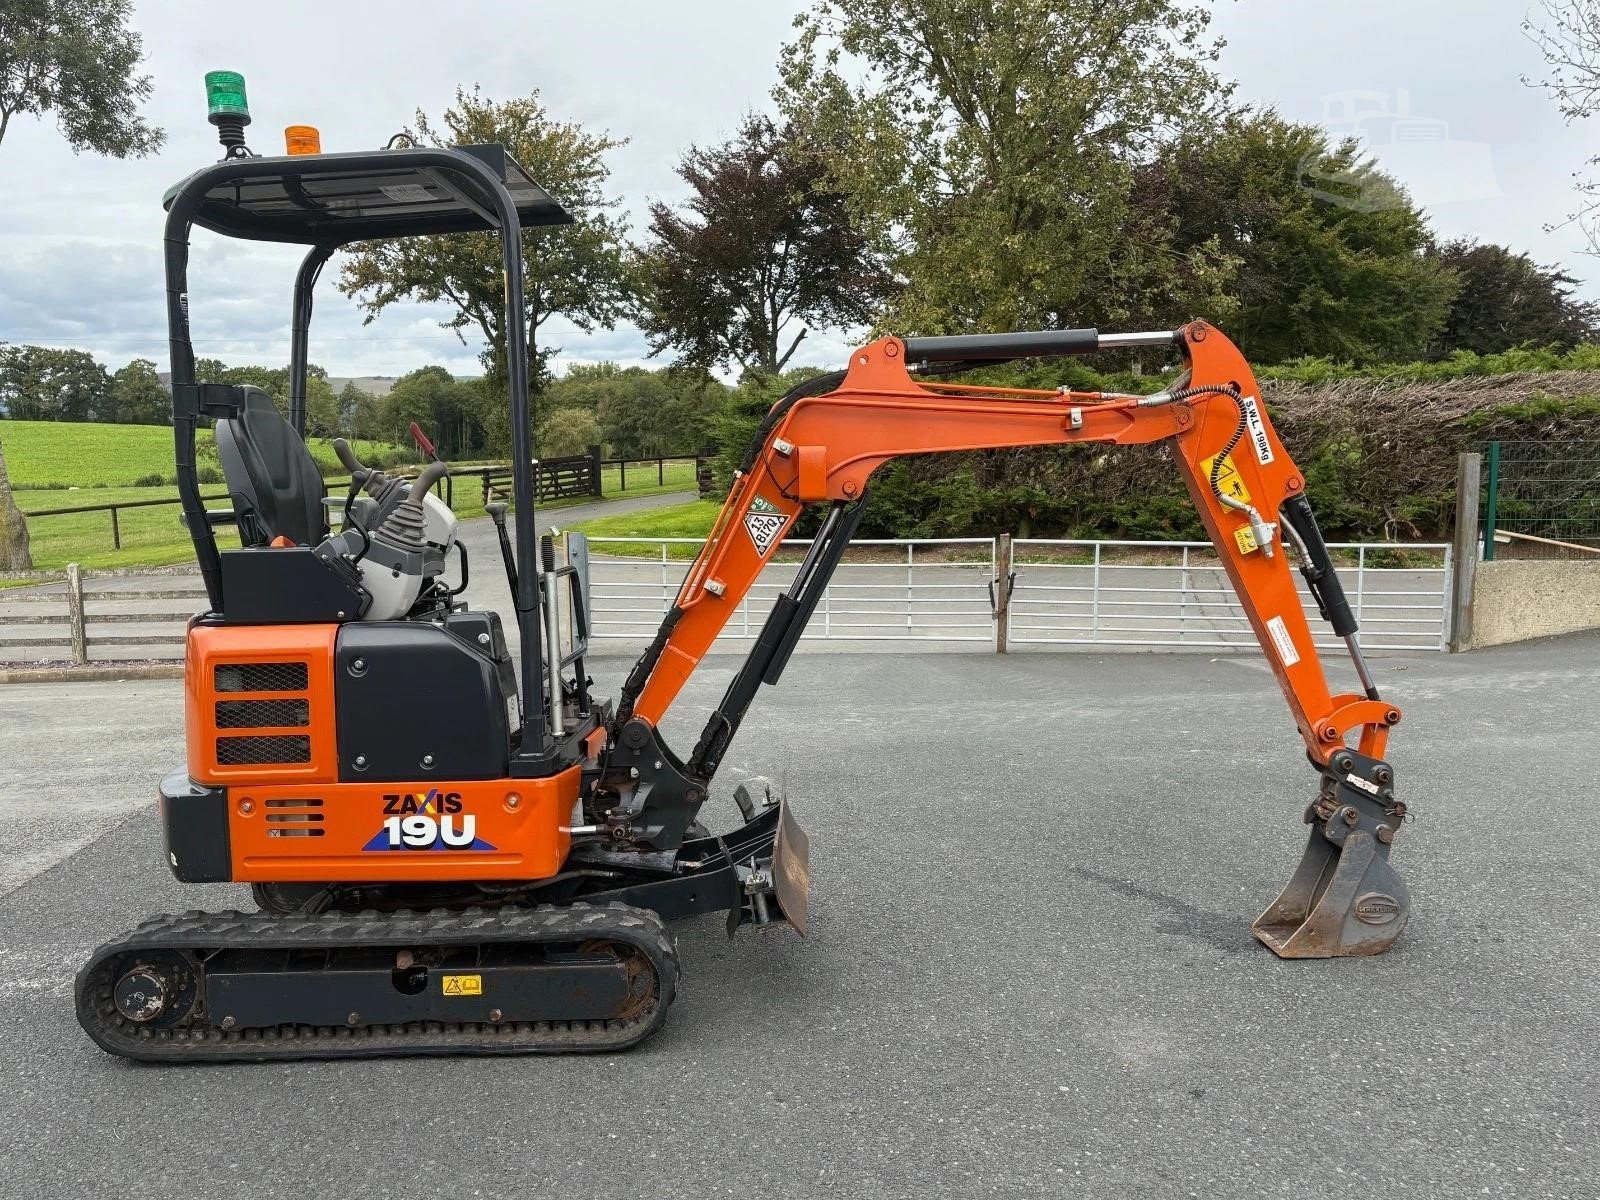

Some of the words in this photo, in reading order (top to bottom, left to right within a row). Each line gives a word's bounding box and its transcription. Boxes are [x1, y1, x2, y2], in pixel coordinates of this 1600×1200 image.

[1246, 400, 1259, 429] S.W.L.
[1255, 430, 1270, 461] 198Kg
[751, 516, 765, 532] 13
[382, 789, 463, 814] ZAXIS
[383, 814, 476, 850] 19U
